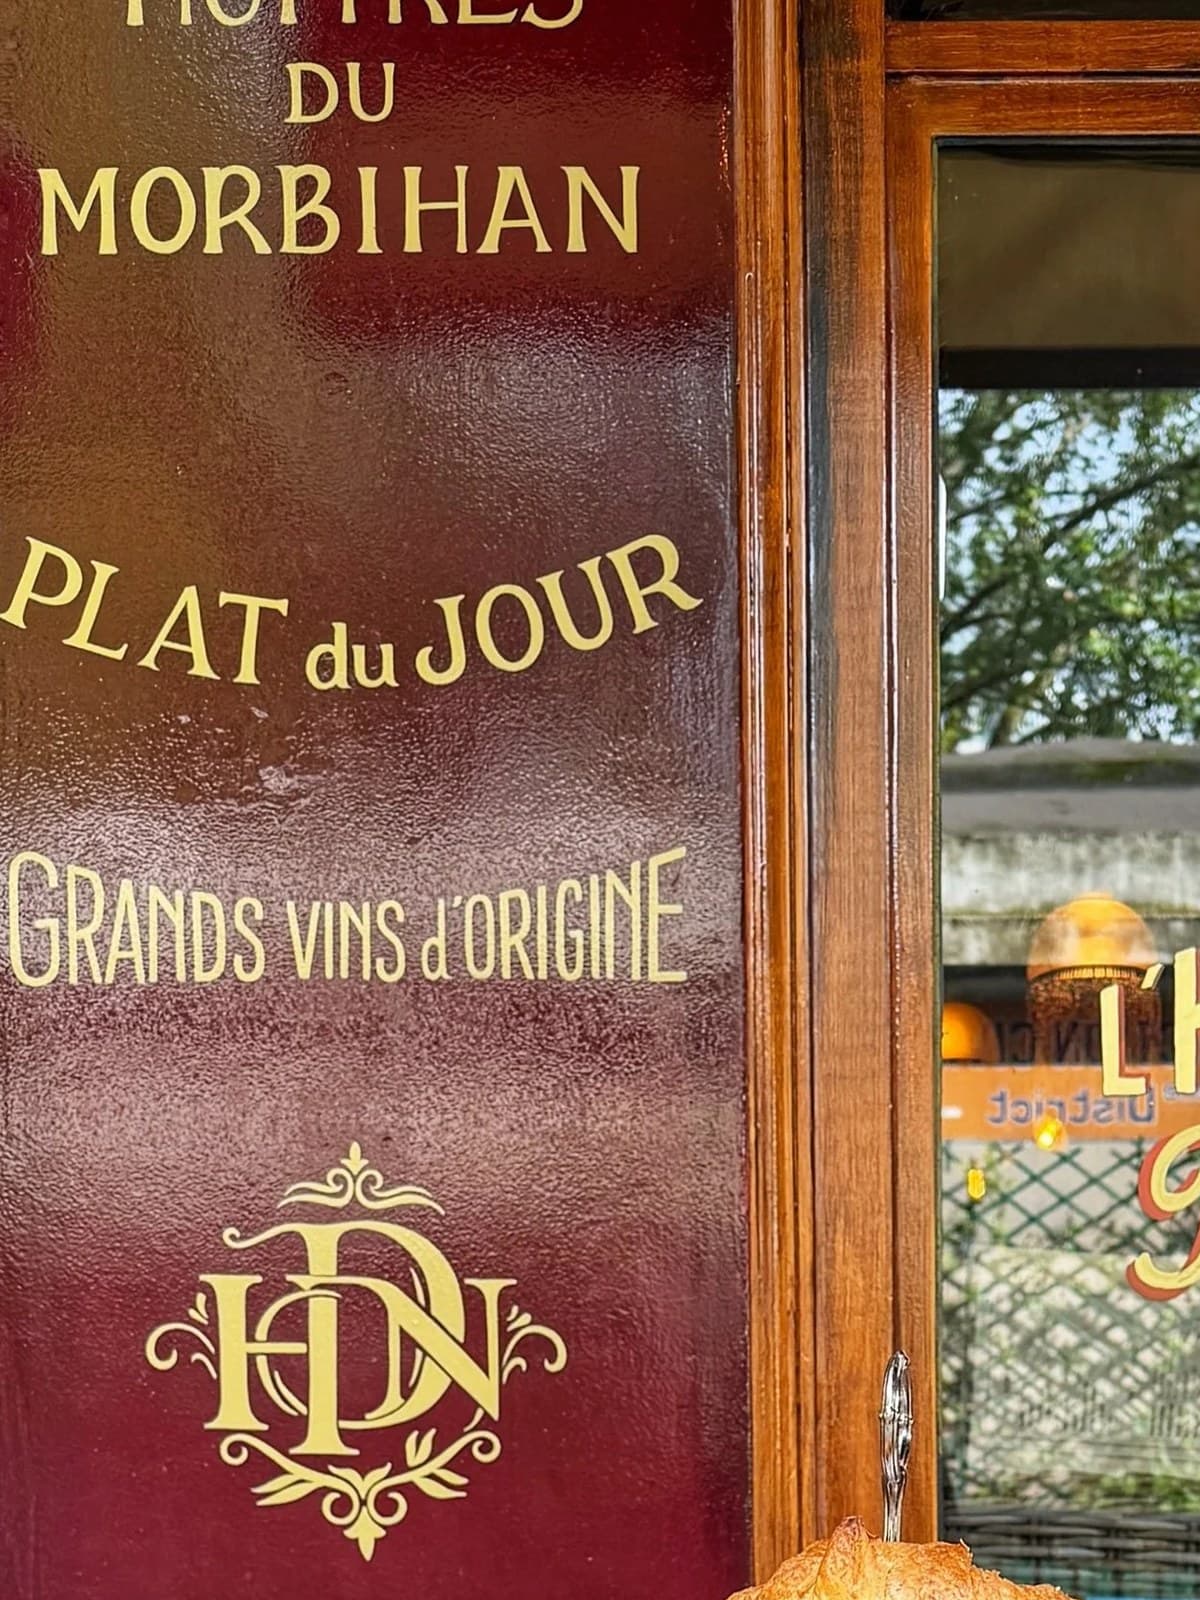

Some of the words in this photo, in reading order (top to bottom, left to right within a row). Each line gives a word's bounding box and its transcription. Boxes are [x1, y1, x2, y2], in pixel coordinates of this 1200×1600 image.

[284, 62, 396, 125] DU
[38, 164, 641, 256] MORBIHAN
[0, 536, 289, 686] PLAT
[305, 622, 399, 691] du
[415, 533, 704, 687] JOUR
[8, 851, 265, 988] GRANDS
[421, 846, 689, 984] d'ORIGINE
